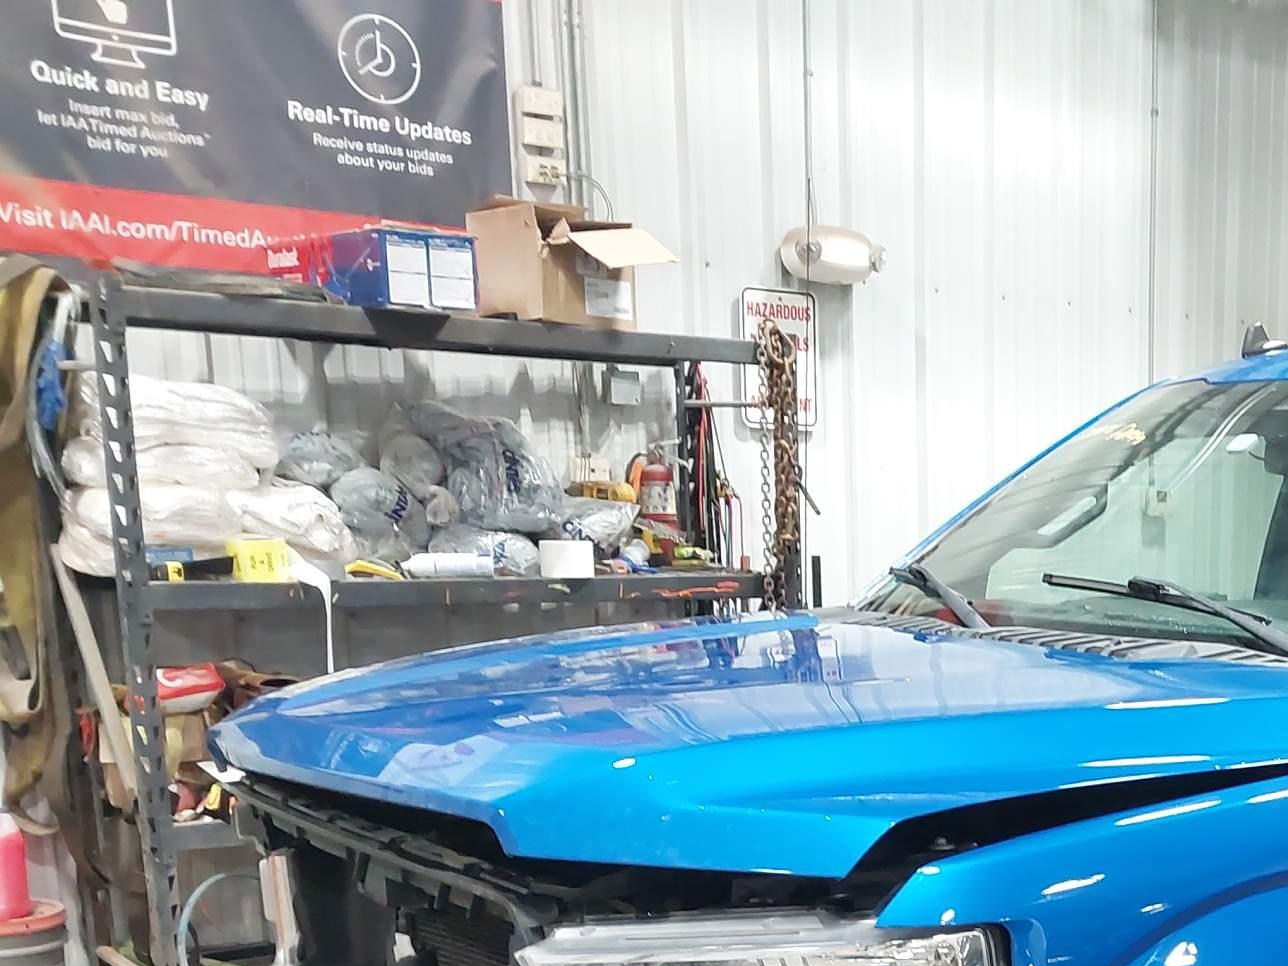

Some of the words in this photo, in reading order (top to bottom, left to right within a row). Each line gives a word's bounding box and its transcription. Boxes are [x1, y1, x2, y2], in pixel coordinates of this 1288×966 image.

[30, 59, 99, 92] Quick
[105, 77, 150, 99] and
[155, 80, 209, 111] Easy
[37, 109, 58, 126] let
[68, 98, 111, 119] Insert
[115, 108, 148, 124] max
[151, 111, 180, 129] bid,
[287, 100, 390, 133] Real-Time
[395, 116, 472, 145] Updates
[86, 134, 111, 151] bid
[114, 138, 137, 154] for
[140, 144, 168, 159] you
[313, 132, 363, 152] Receive
[366, 141, 403, 157] status
[406, 148, 453, 165] updates
[337, 152, 375, 169] about
[377, 158, 405, 173] your
[408, 160, 434, 177] bids
[0, 201, 55, 229] Visit
[746, 301, 811, 322] HAZARDOUS
